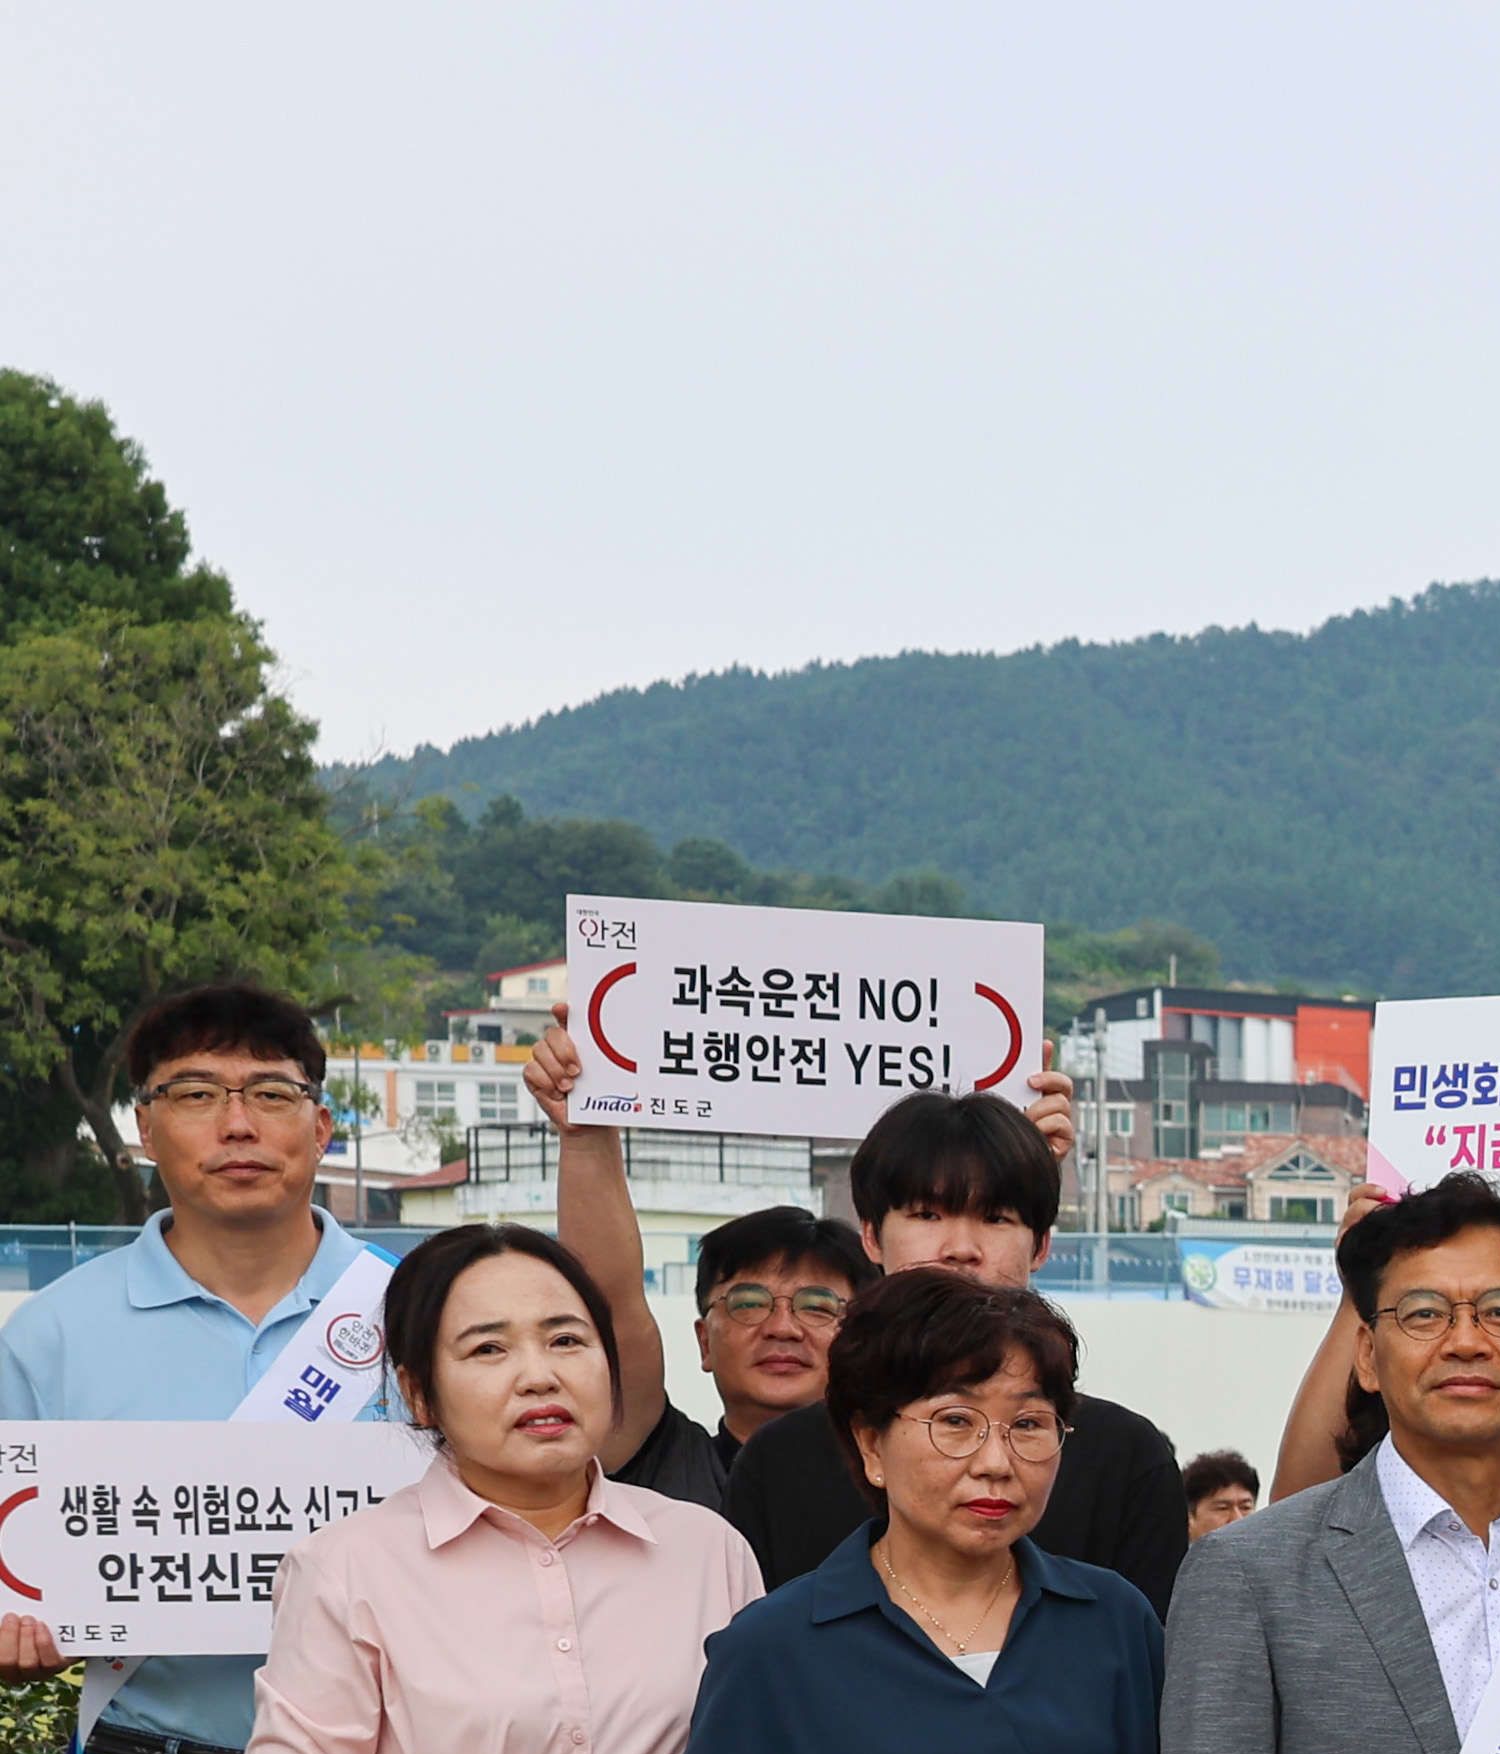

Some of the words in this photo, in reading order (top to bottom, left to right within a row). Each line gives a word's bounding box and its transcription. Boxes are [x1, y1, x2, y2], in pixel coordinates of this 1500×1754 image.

[579, 918, 637, 950] 안전
[672, 964, 840, 1021] 과속운전
[859, 978, 938, 1028] NO!
[659, 1031, 827, 1086] 보행안전
[844, 1043, 951, 1091] YES!
[580, 1096, 634, 1114] Jindo
[650, 1098, 712, 1118] 진도군
[1234, 1266, 1295, 1290] 무재해
[284, 1365, 341, 1421] 매월
[60, 1485, 120, 1537] 생활
[132, 1485, 161, 1536] 속
[173, 1485, 293, 1536] 위험요소
[59, 1625, 128, 1643] 진도군
